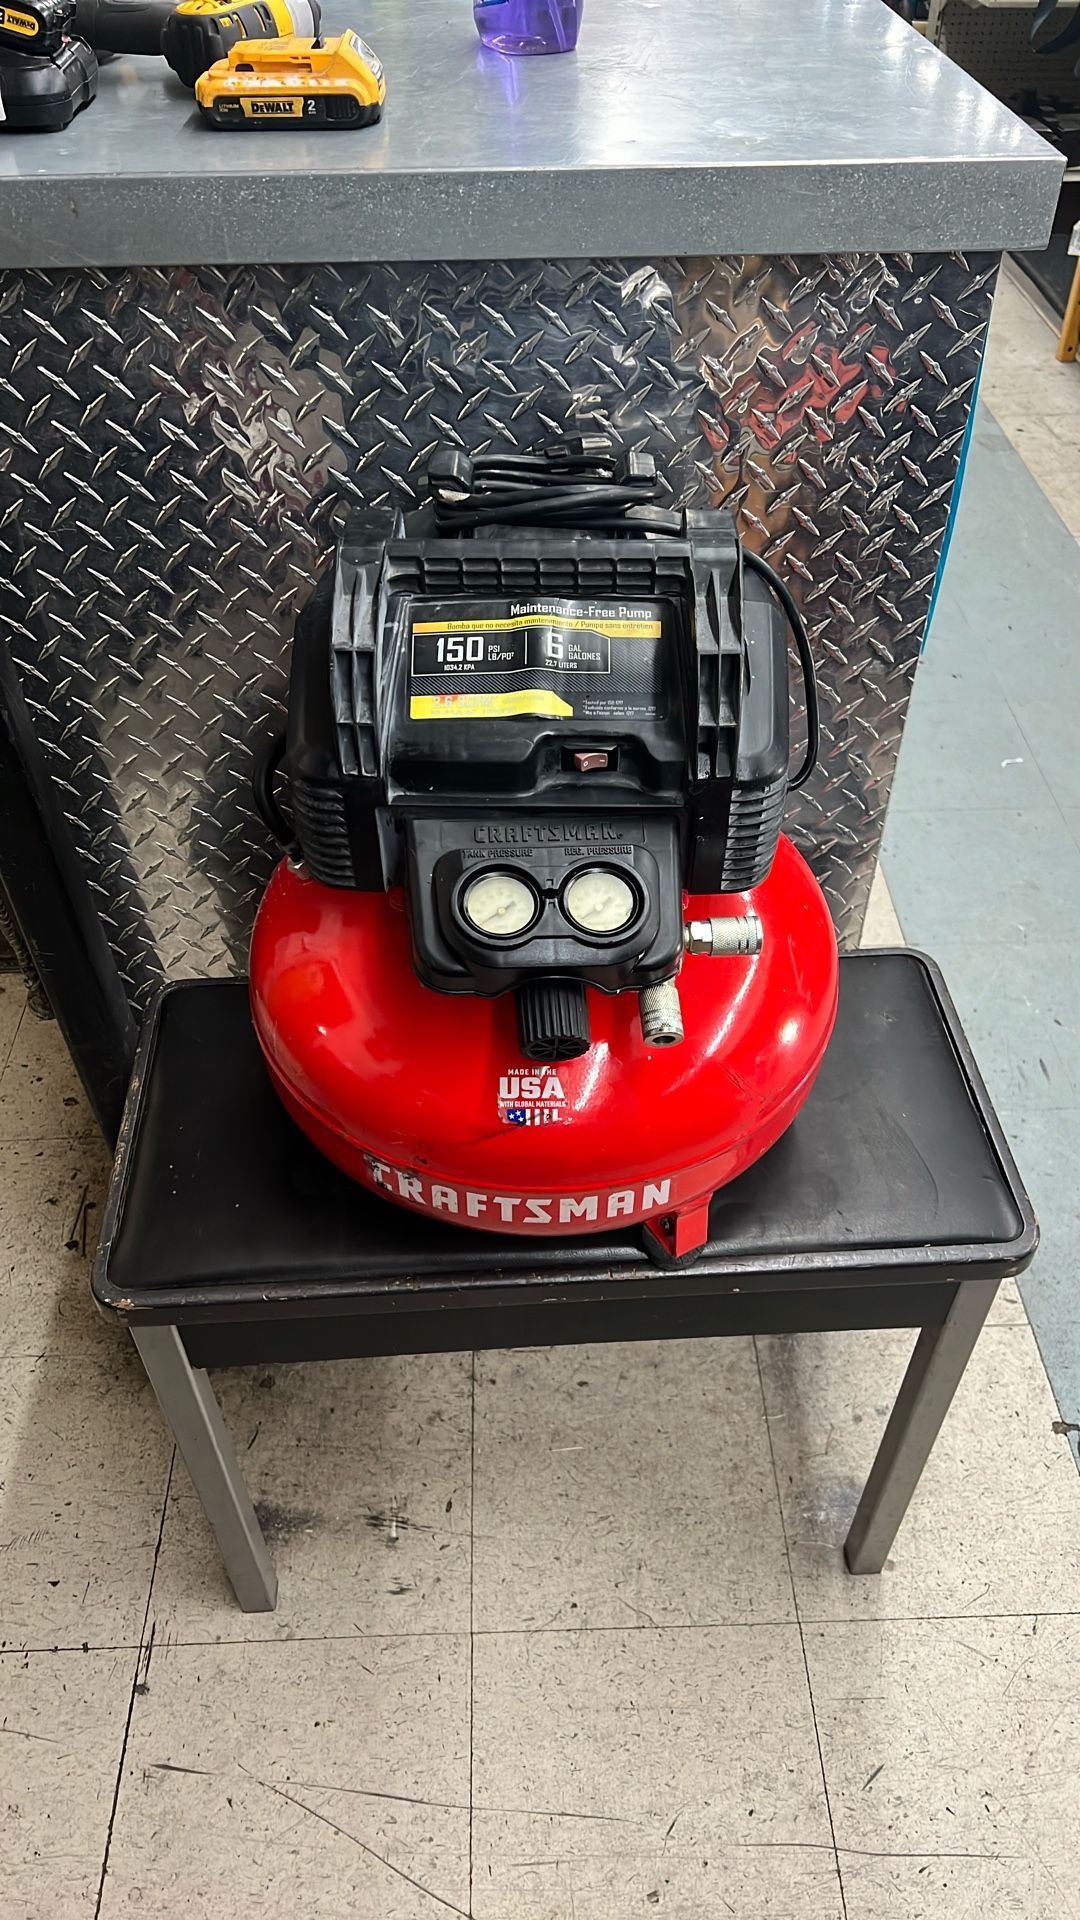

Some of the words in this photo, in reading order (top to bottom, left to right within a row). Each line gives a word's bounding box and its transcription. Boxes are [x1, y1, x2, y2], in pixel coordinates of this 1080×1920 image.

[307, 100, 316, 111] 2
[510, 603, 615, 618] Maintenance-Free
[619, 606, 652, 620] Pump
[447, 622, 470, 630] Bomba
[471, 623, 484, 631] que
[495, 618, 523, 629] necesita
[524, 616, 573, 627] mantenimiento
[581, 620, 604, 630] Pompe
[622, 621, 654, 630] entretien
[436, 636, 484, 662] 150
[488, 645, 500, 653] PSI
[547, 631, 564, 659] 6
[568, 644, 582, 652] GAL
[568, 652, 601, 661] GALONES
[545, 659, 558, 667] 22.7
[558, 661, 578, 669] LITERS
[473, 823, 618, 844] CRAFTSMAN
[462, 849, 486, 859] TANK
[487, 849, 533, 858] PRESSURE
[587, 846, 633, 856] PRESSURE
[508, 1068, 529, 1076] MADE
[532, 1068, 540, 1076] IN
[499, 1076, 565, 1099] USA
[514, 1100, 535, 1108] GLOBAL
[536, 1100, 567, 1108] MATERIALS
[368, 1158, 672, 1224] CRAFTSMAN
